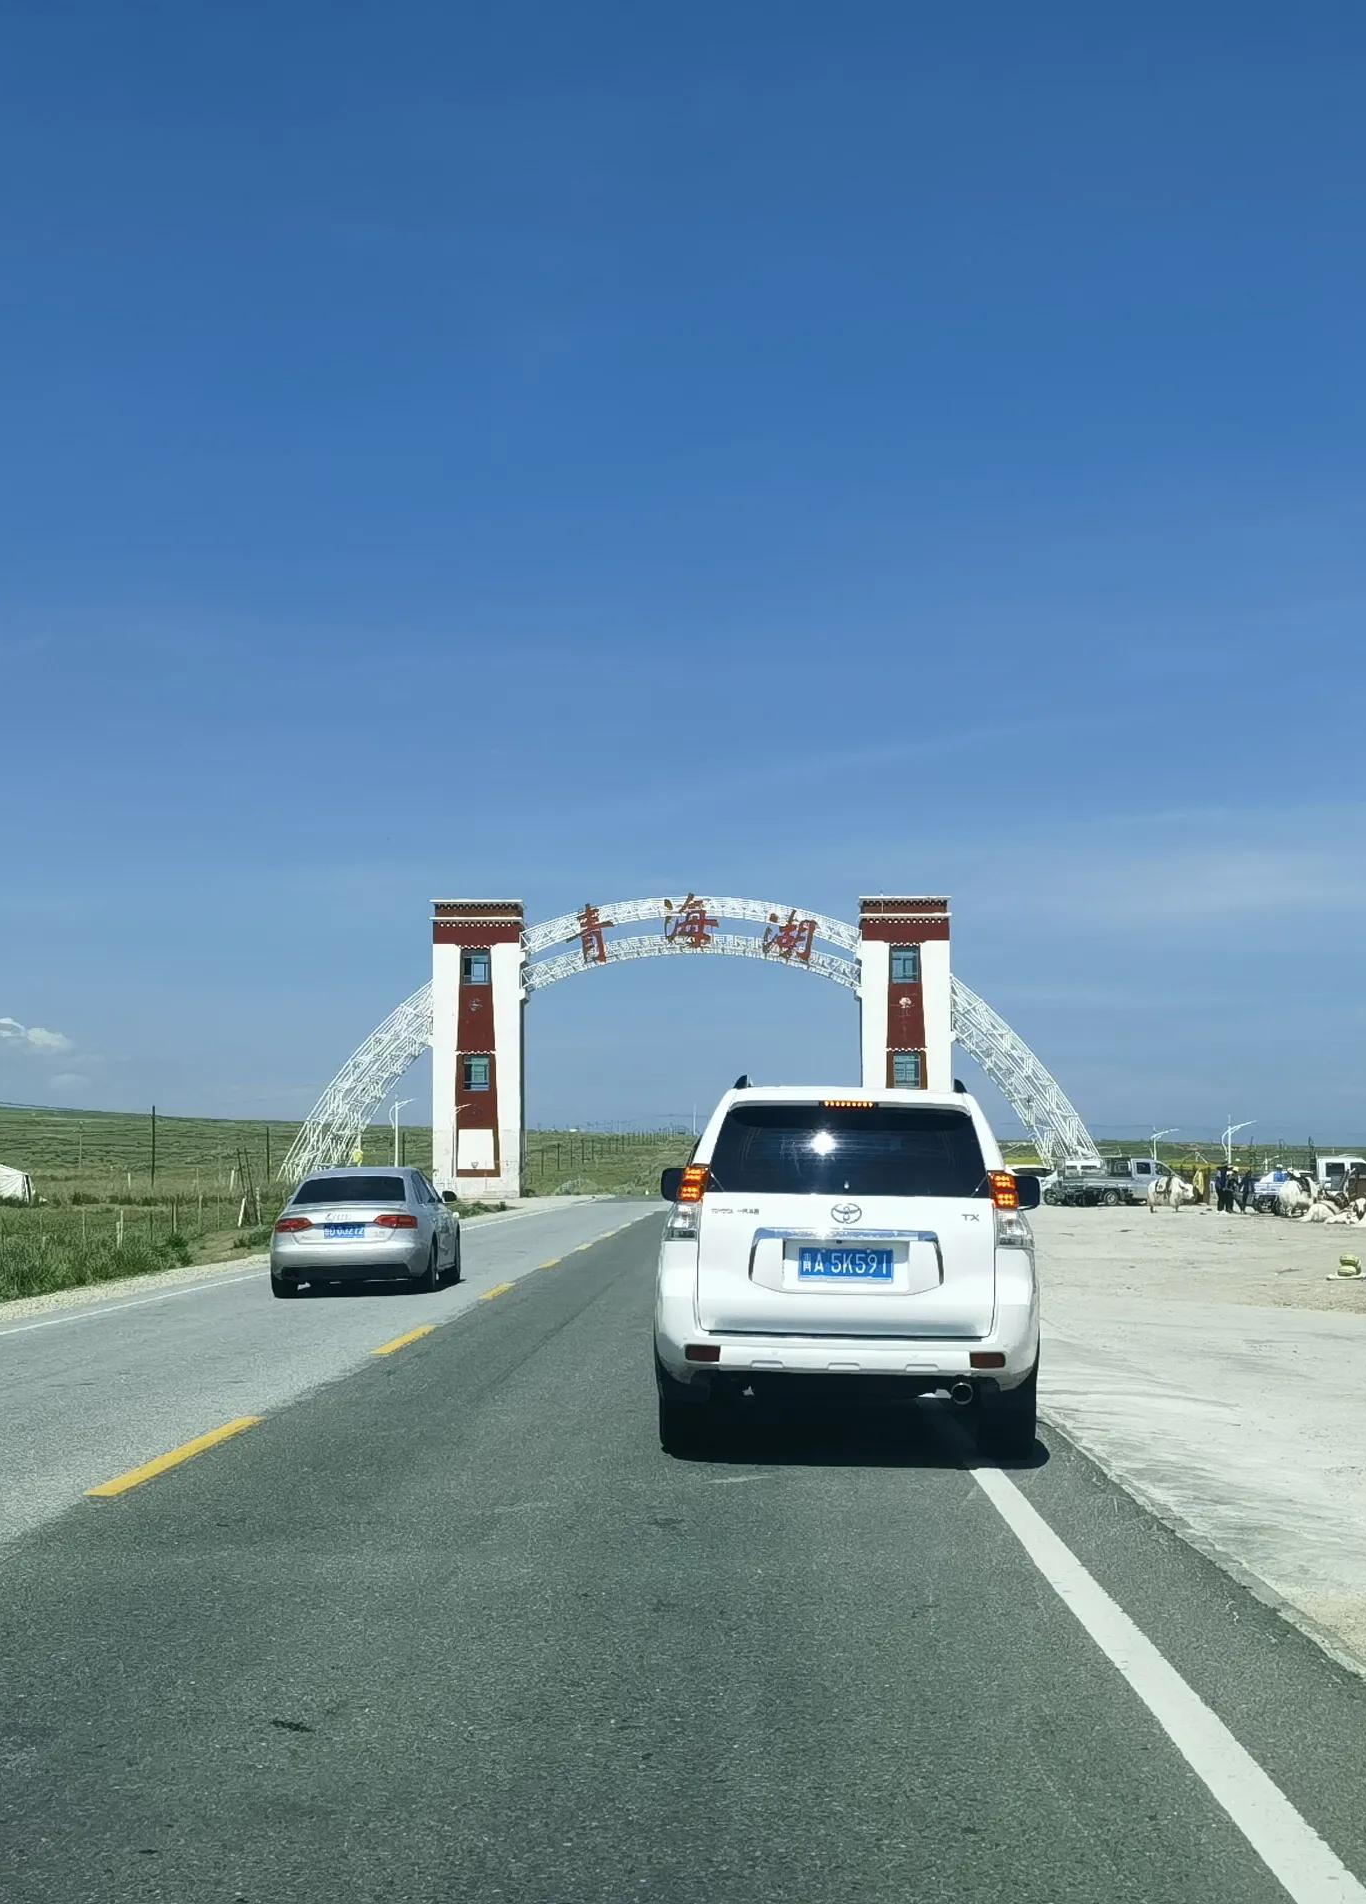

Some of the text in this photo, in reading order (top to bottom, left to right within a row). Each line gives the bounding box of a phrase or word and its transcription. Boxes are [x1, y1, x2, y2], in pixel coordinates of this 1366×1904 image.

[566, 893, 818, 963] 青海湖
[961, 1213, 980, 1222] TX
